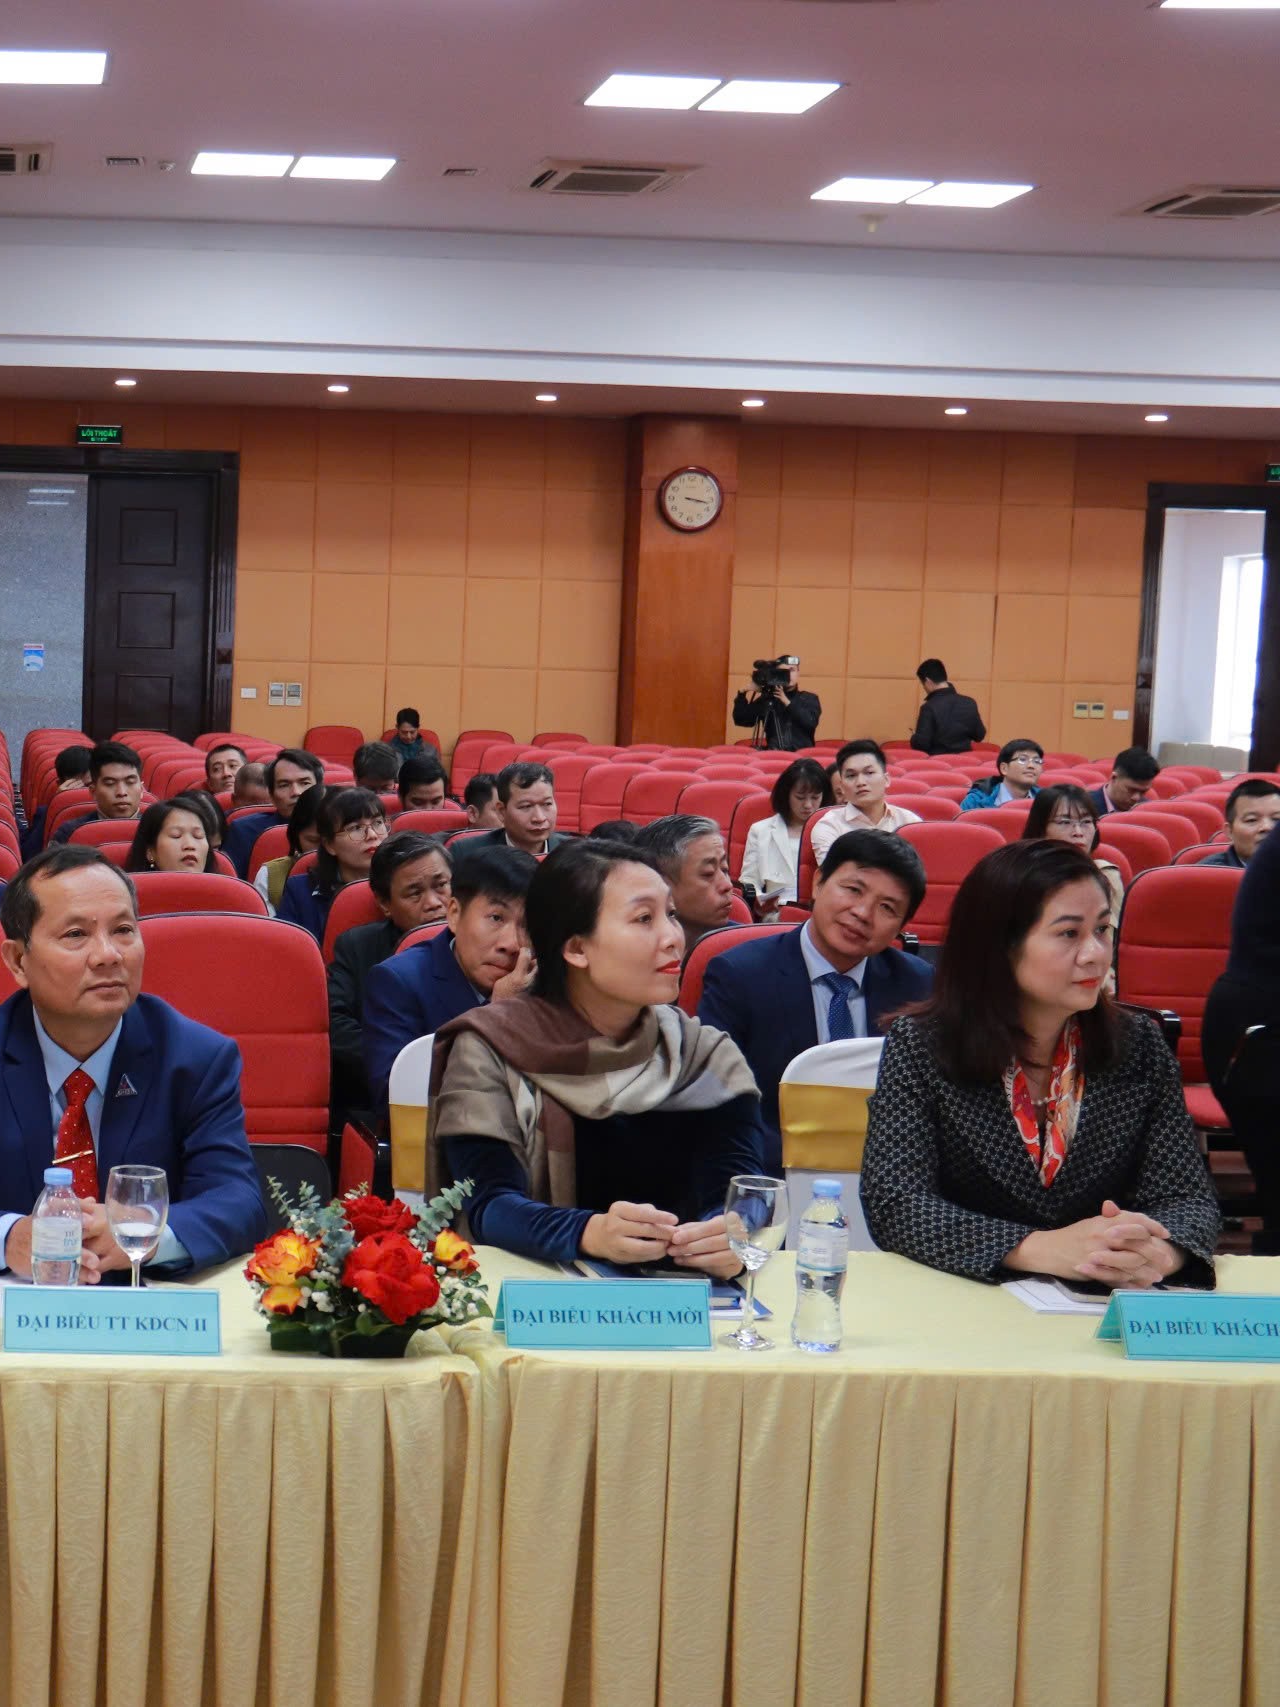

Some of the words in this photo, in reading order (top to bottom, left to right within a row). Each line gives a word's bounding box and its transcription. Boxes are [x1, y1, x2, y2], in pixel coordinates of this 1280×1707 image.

[16, 1314, 50, 1333] ĐẠI
[104, 1315, 131, 1330] TT
[194, 1318, 207, 1332] II
[512, 1309, 545, 1327] ĐẠI
[596, 1305, 663, 1325] KHÁCH
[667, 1306, 704, 1325] MỜI
[1128, 1320, 1162, 1338] ĐẠI
[1212, 1317, 1280, 1337] KHÁCH
